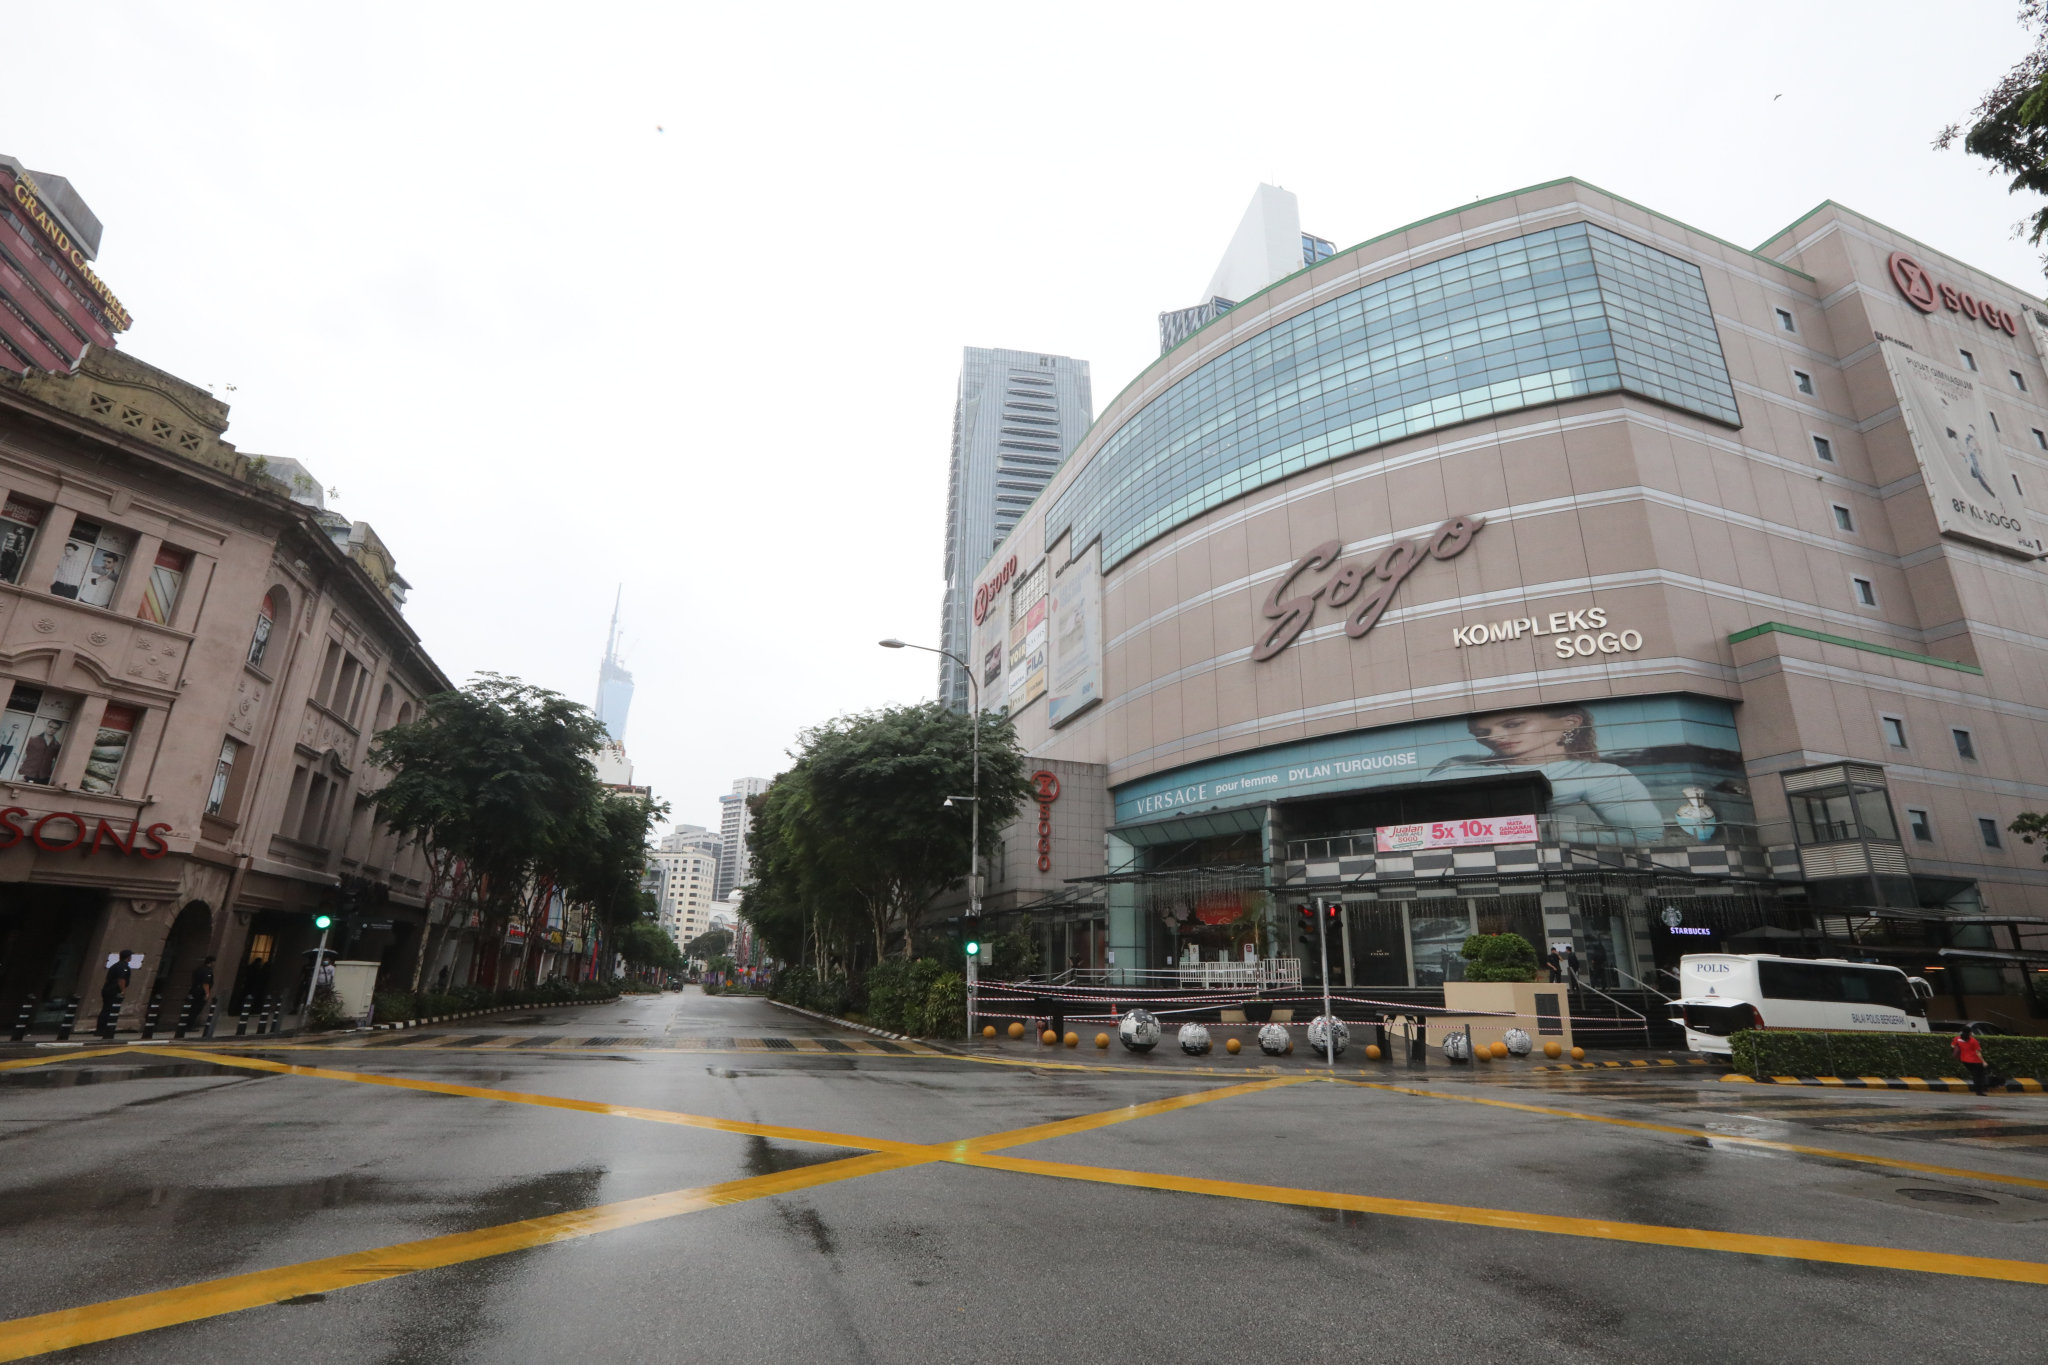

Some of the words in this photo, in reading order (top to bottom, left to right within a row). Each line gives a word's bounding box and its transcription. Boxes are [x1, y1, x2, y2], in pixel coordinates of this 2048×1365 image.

[14, 184, 70, 252] GRAND
[71, 250, 130, 325] CAMPBELL
[104, 306, 125, 332] HOTEL
[1939, 282, 2018, 338] SOGO
[1952, 498, 1966, 514] 8F
[1968, 503, 1983, 521] KL
[1983, 509, 2022, 532] SOGO
[988, 554, 1018, 602] SOGO
[1252, 515, 1487, 662] Sogo
[1453, 607, 1609, 648] KOMPLEKS
[1554, 628, 1643, 659] SOGO
[1026, 650, 1044, 676] FILA
[1137, 784, 1208, 815] VERSACE
[1215, 780, 1239, 796] pour
[1241, 774, 1279, 790] femme
[1288, 763, 1331, 782] DYLAN
[1333, 751, 1417, 774] TURQUOISE
[1038, 802, 1051, 873] SOGO
[1389, 825, 1424, 838] Jualan
[1431, 823, 1455, 840] 5x
[1459, 819, 1494, 837] 10x
[1670, 926, 1711, 936] STARBUCKS
[1697, 963, 1730, 973] POLIS
[1866, 1014, 1880, 1025] POLIS
